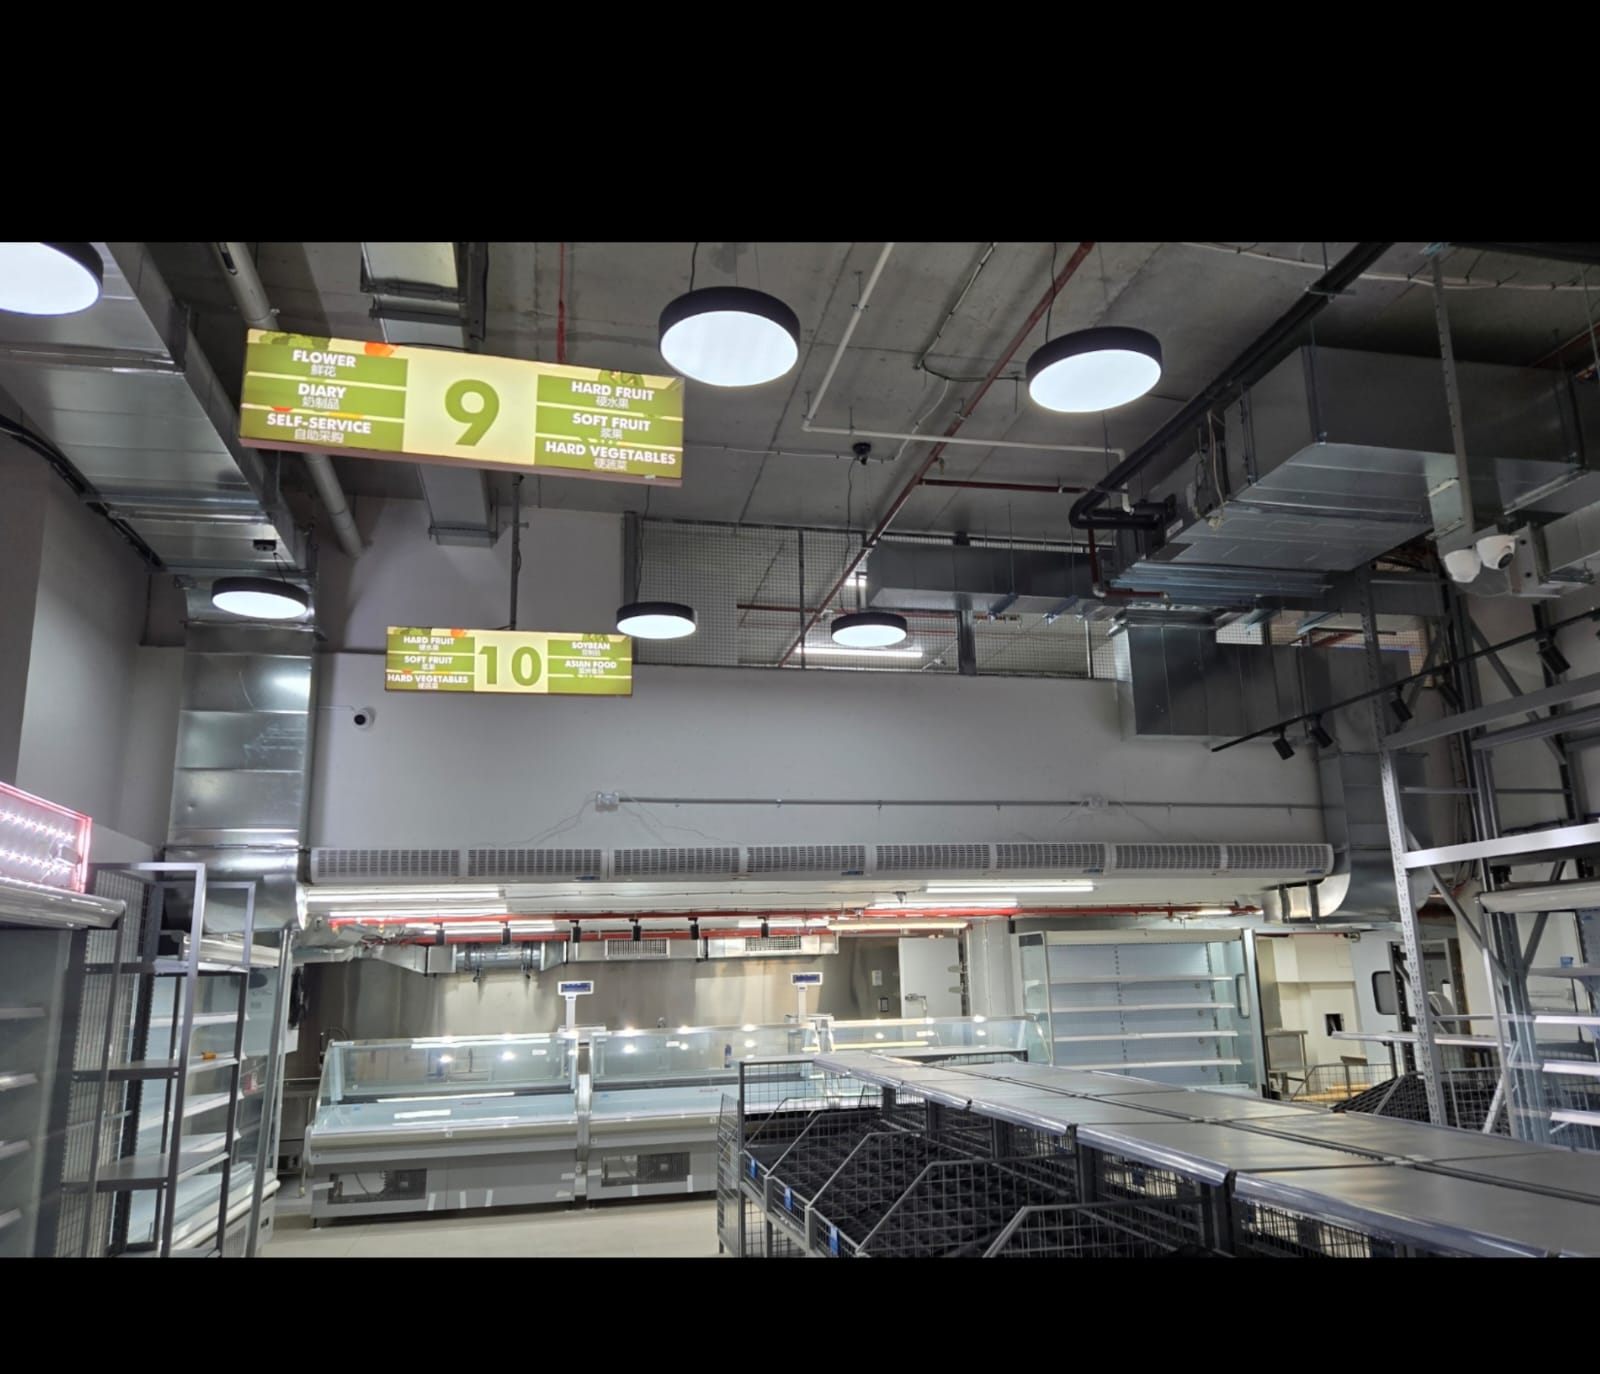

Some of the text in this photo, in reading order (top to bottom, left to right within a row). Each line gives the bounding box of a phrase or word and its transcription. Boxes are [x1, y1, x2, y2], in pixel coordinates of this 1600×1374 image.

[292, 349, 356, 368] FLOWER
[298, 383, 347, 398] DIARY
[571, 381, 655, 401] HARD FRUIT
[444, 379, 500, 447] 9
[572, 412, 651, 432] SOFT FRUIT
[266, 413, 372, 434] SELF-SERVICE
[545, 440, 676, 465] HARD VEGETABLES
[403, 636, 455, 645] HARD FRUIT
[571, 641, 610, 650] SOYBEAN
[403, 655, 453, 664] SOFT FRUIT
[478, 645, 542, 687] 10
[565, 660, 617, 669] ASIAN FOOD
[387, 673, 468, 684] HARD VEGETABLES
